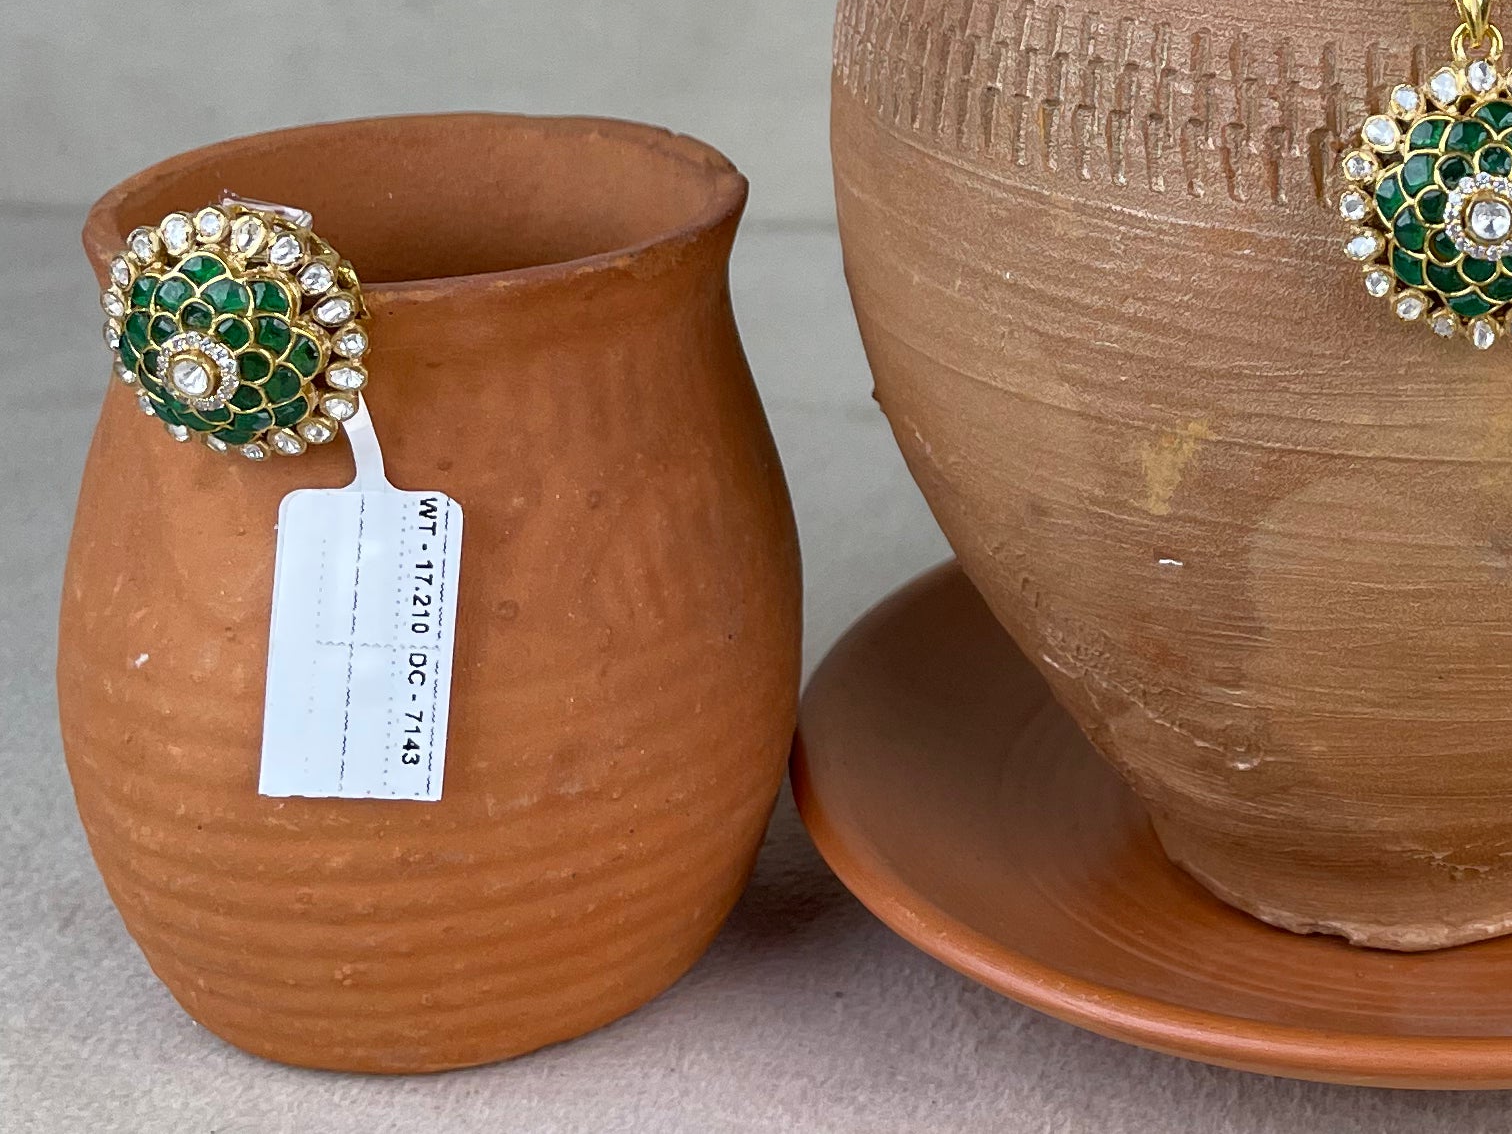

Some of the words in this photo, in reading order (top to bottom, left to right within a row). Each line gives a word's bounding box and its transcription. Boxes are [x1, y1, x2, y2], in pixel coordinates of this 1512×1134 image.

[418, 497, 438, 535] WT
[410, 560, 435, 634] 17.210
[407, 653, 428, 687] DC
[401, 710, 424, 765] 7143
